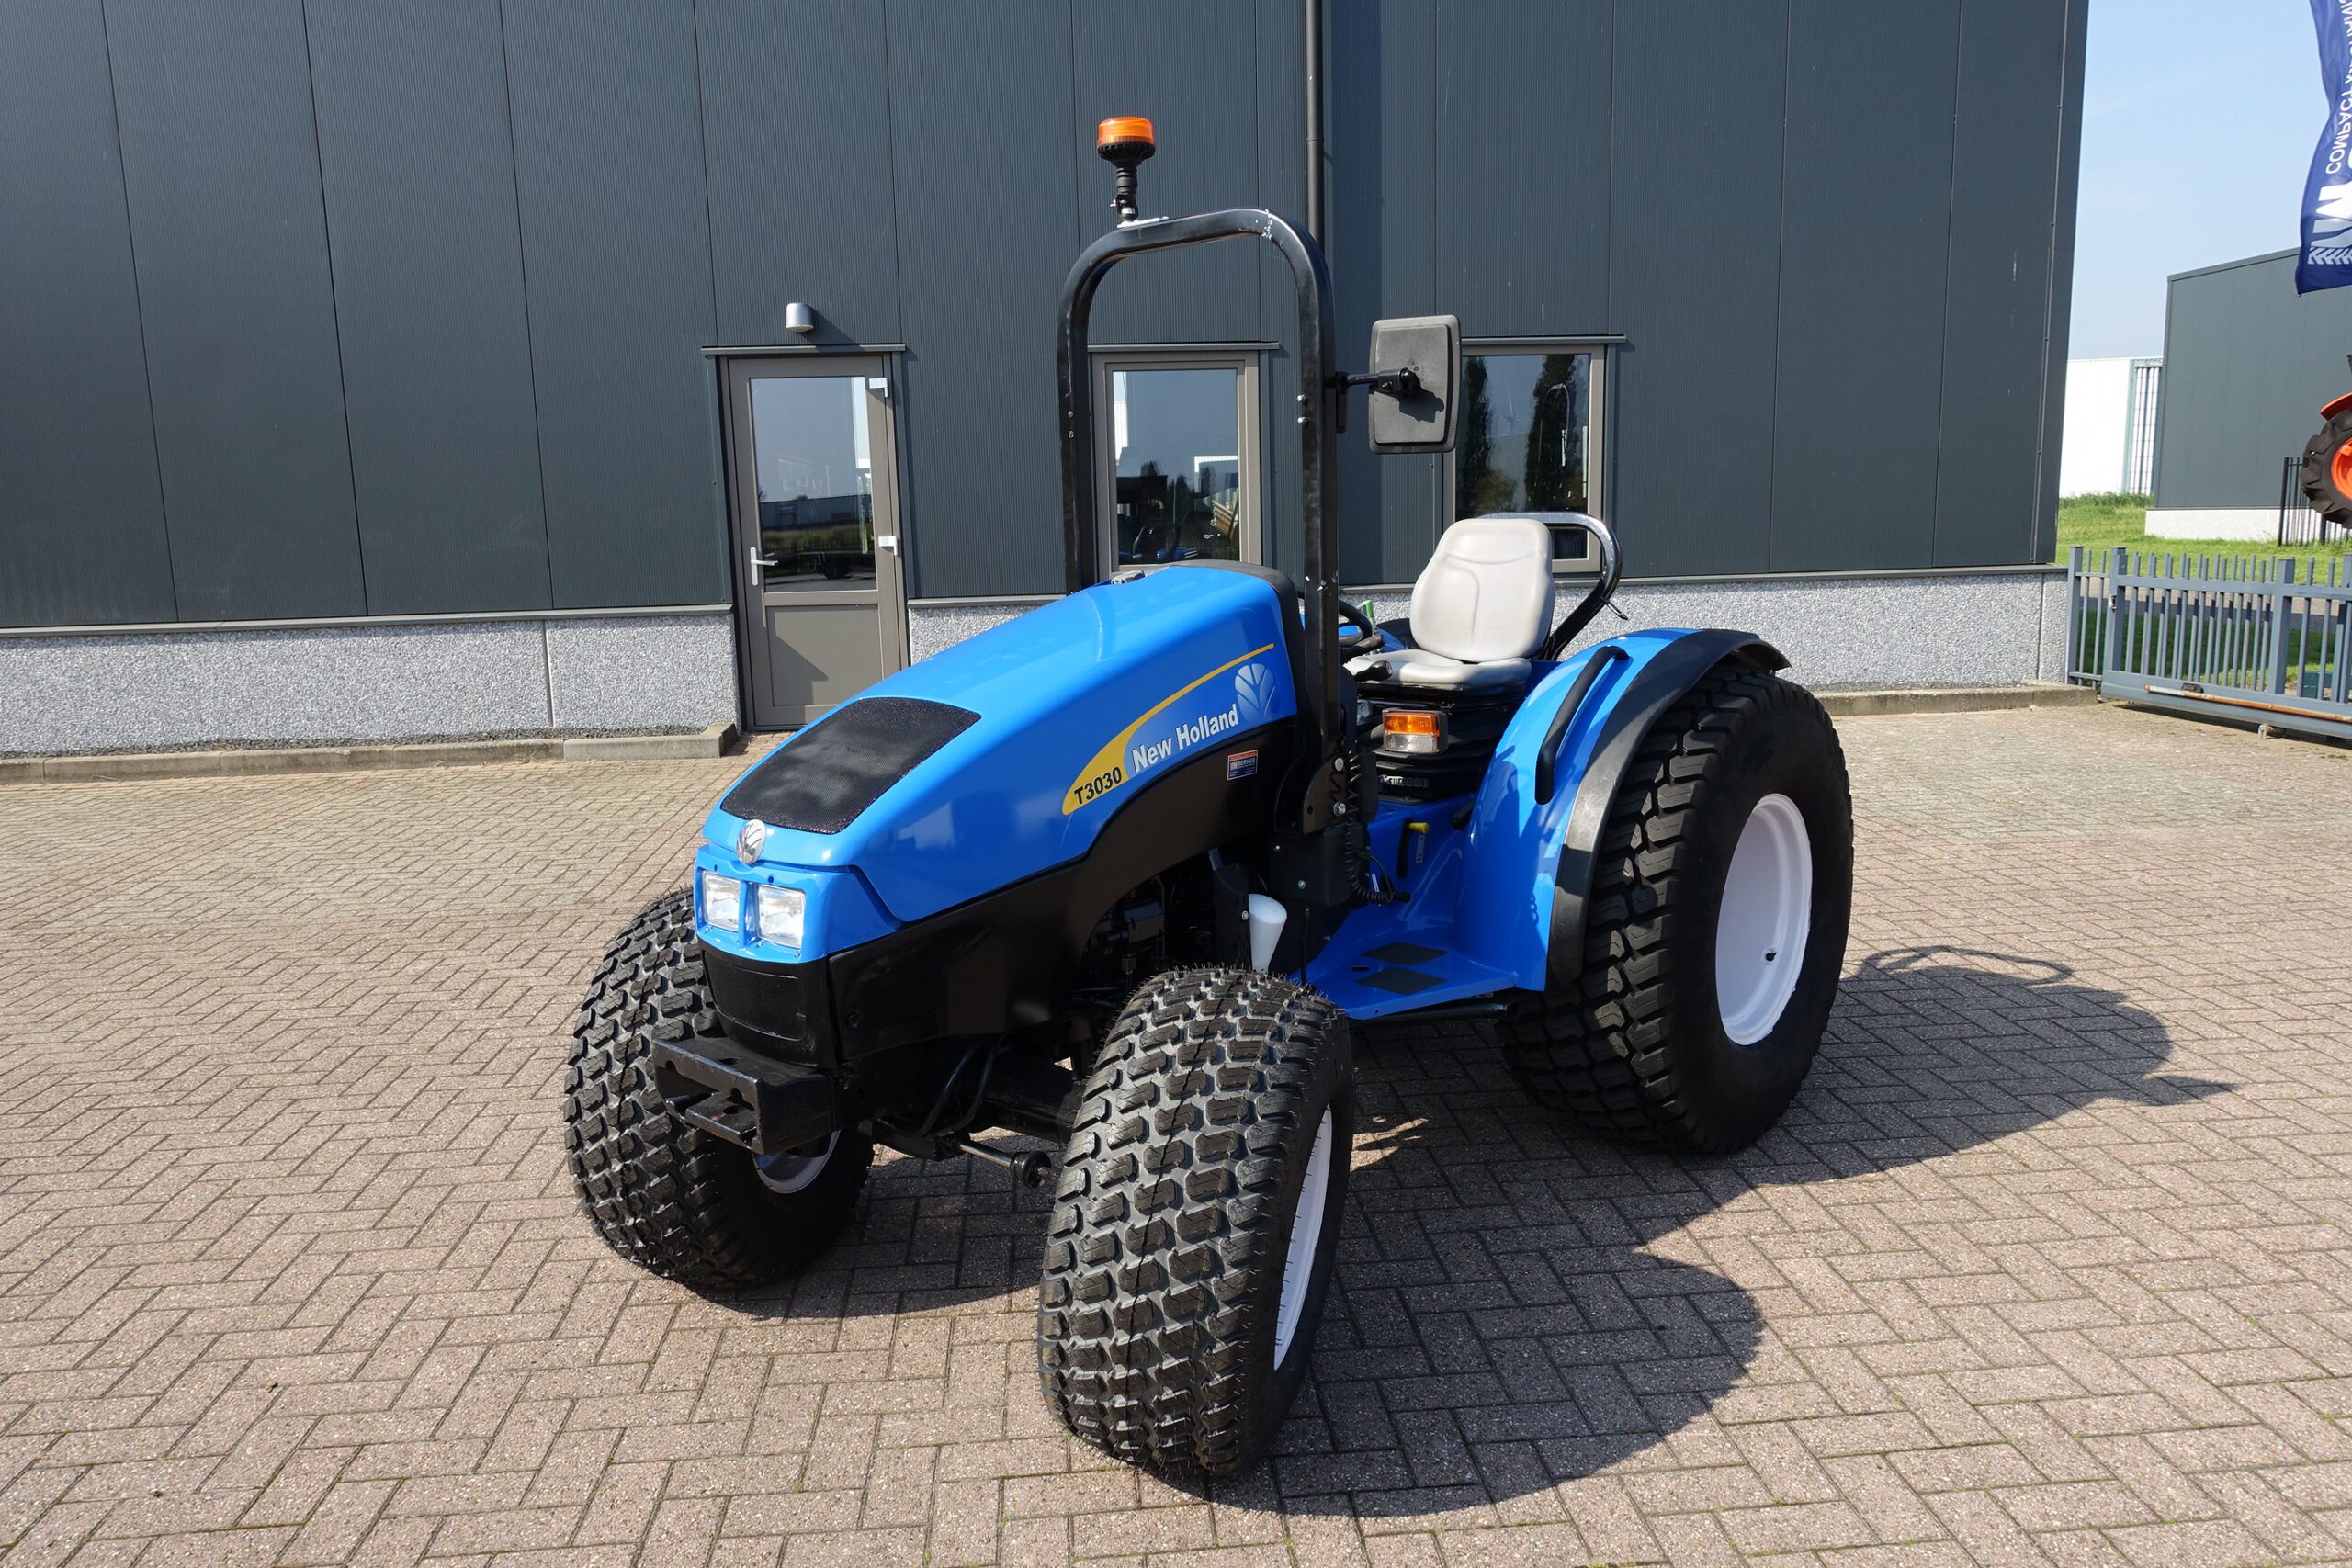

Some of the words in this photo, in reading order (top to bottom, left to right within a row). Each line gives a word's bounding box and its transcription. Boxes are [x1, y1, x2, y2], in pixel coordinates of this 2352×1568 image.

[1132, 738, 1171, 773] New
[1176, 703, 1238, 750] Holland
[1074, 766, 1122, 805] T3030
